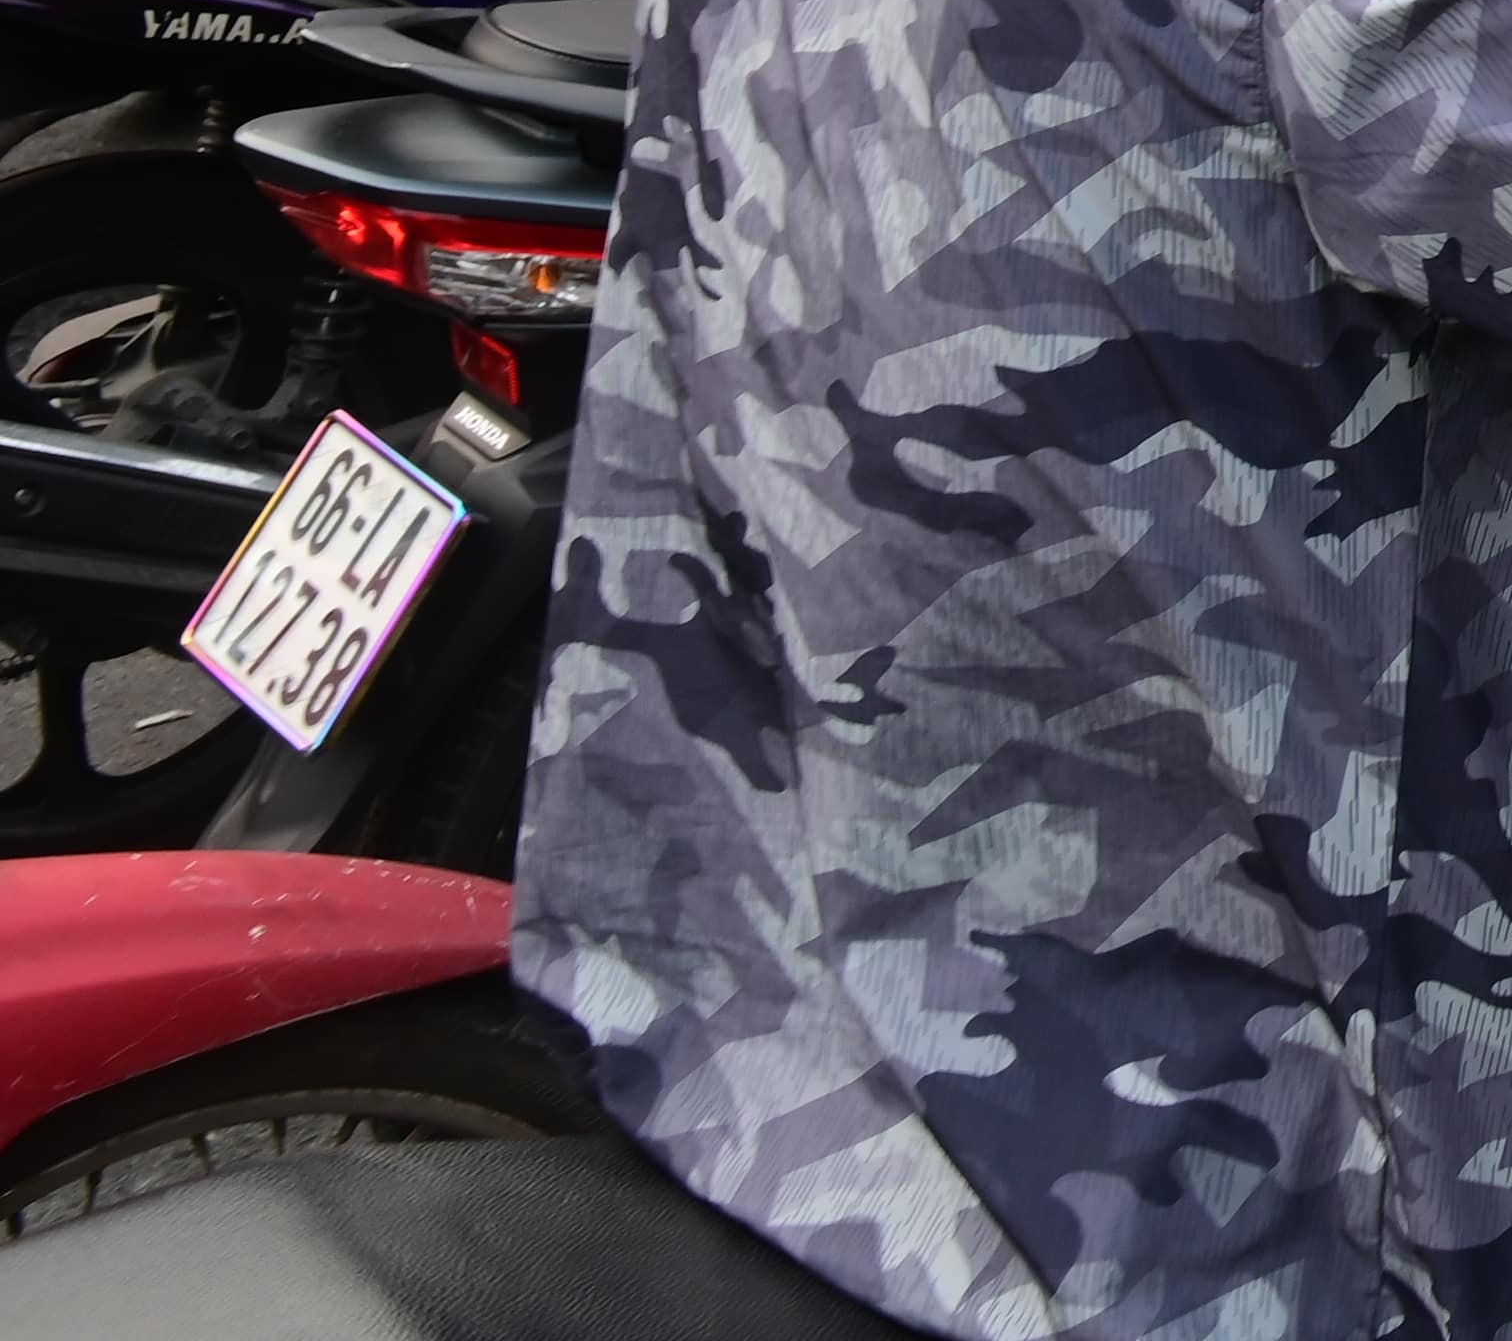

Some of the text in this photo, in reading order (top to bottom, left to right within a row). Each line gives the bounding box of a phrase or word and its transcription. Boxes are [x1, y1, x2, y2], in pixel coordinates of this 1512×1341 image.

[454, 405, 512, 451] HONDA
[290, 447, 432, 610] 66-LA
[213, 548, 369, 727] 127.38
